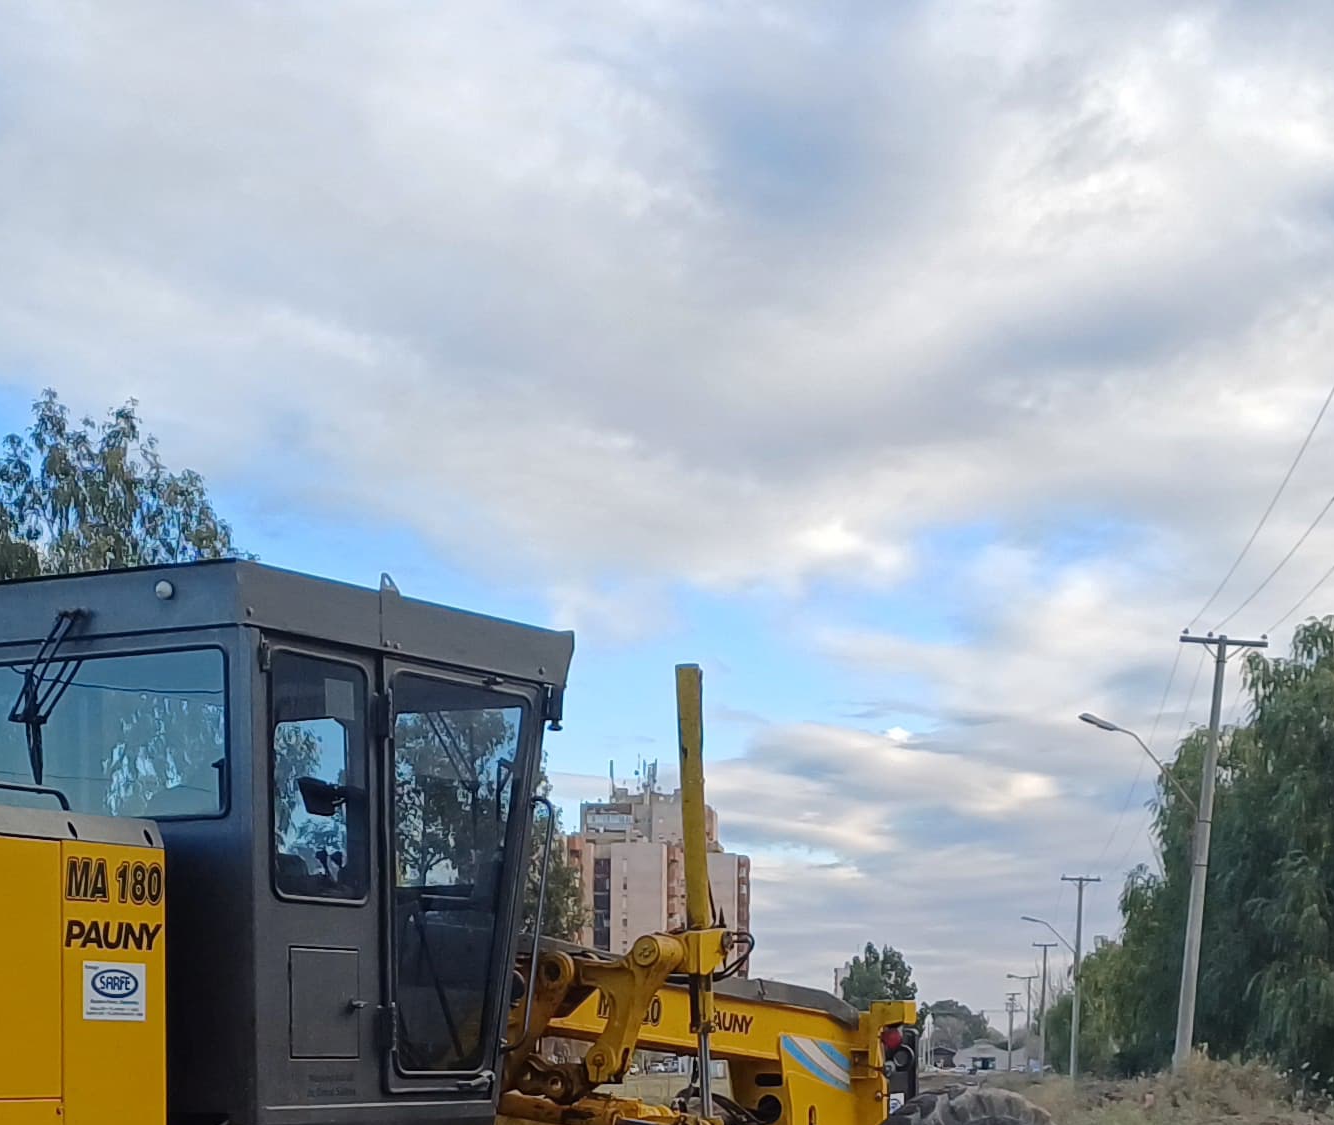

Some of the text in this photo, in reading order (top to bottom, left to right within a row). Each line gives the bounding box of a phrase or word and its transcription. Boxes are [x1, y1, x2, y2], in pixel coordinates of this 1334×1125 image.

[66, 857, 163, 906] MA 180
[65, 919, 162, 950] PAUNY
[713, 1006, 754, 1035] AUNY
